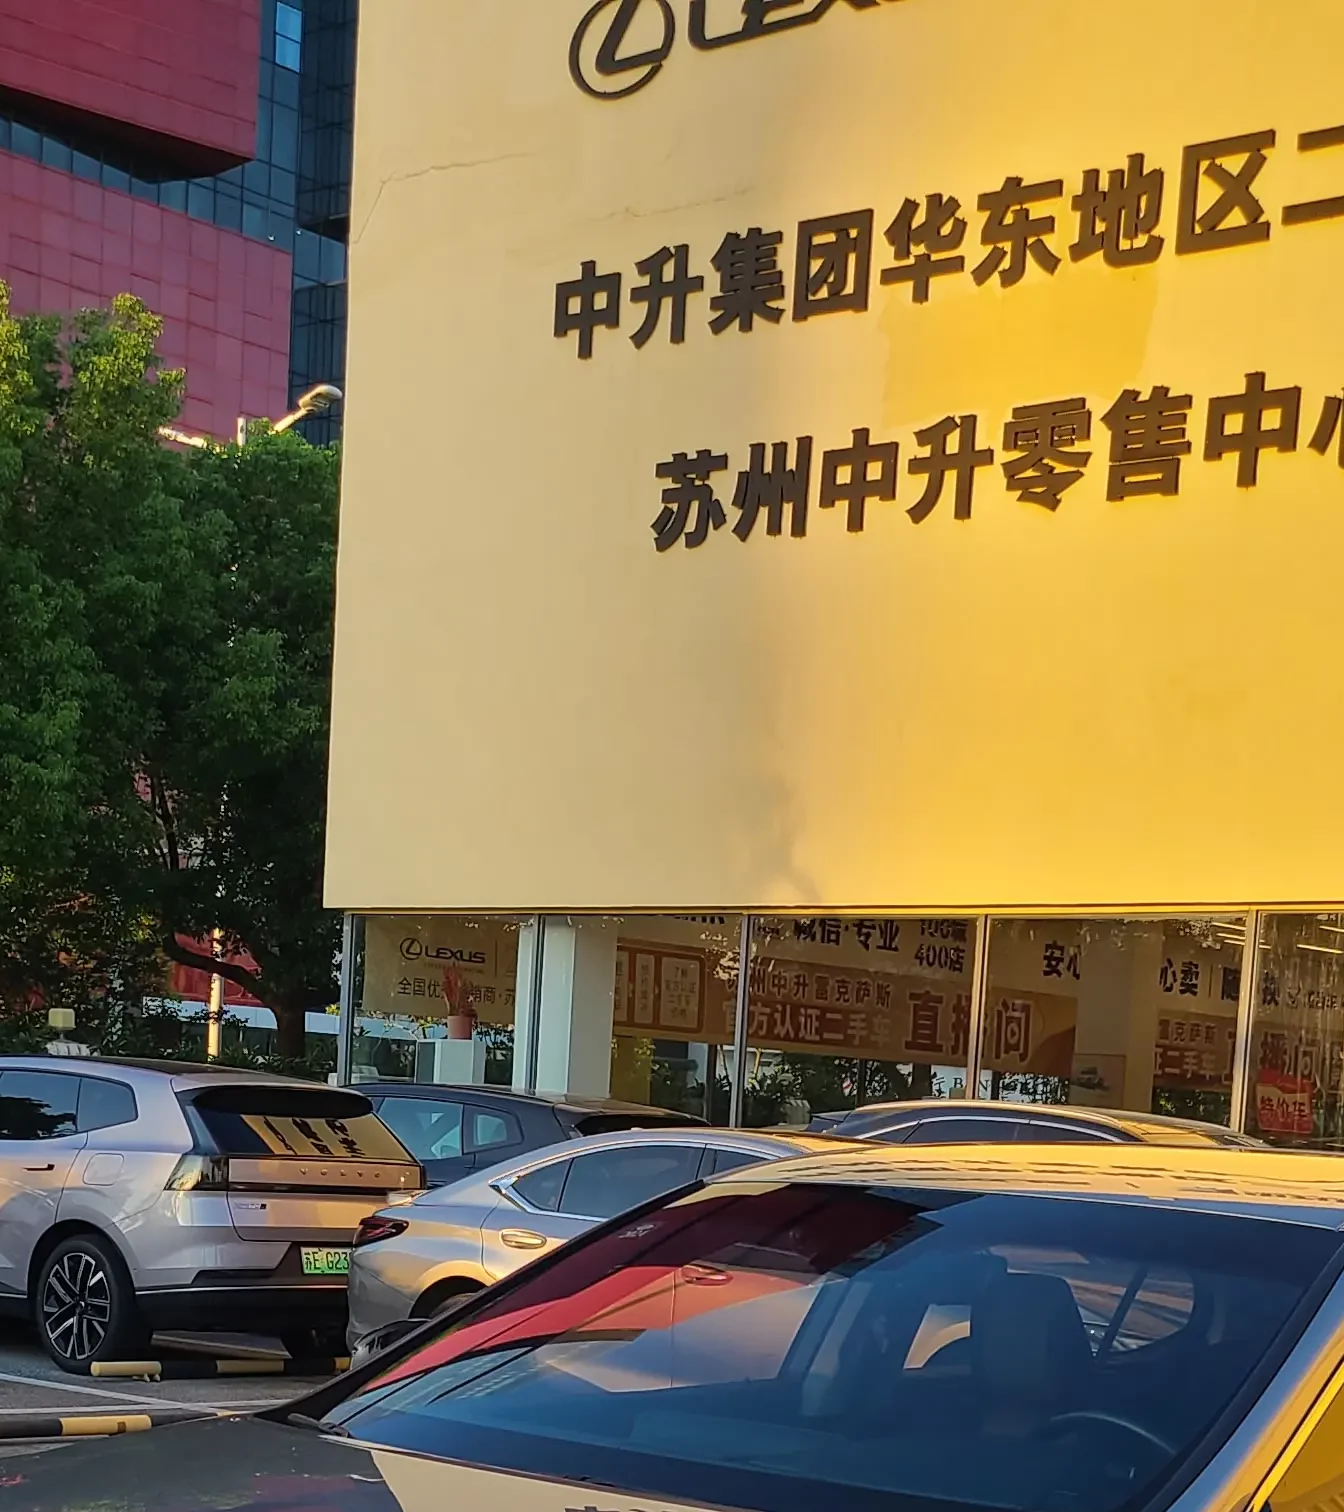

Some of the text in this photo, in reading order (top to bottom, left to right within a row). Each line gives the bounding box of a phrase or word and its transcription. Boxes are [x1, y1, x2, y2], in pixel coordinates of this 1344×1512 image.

[424, 945, 486, 964] LEXUS
[914, 943, 966, 974] 400店
[299, 1167, 382, 1178] VOLVO
